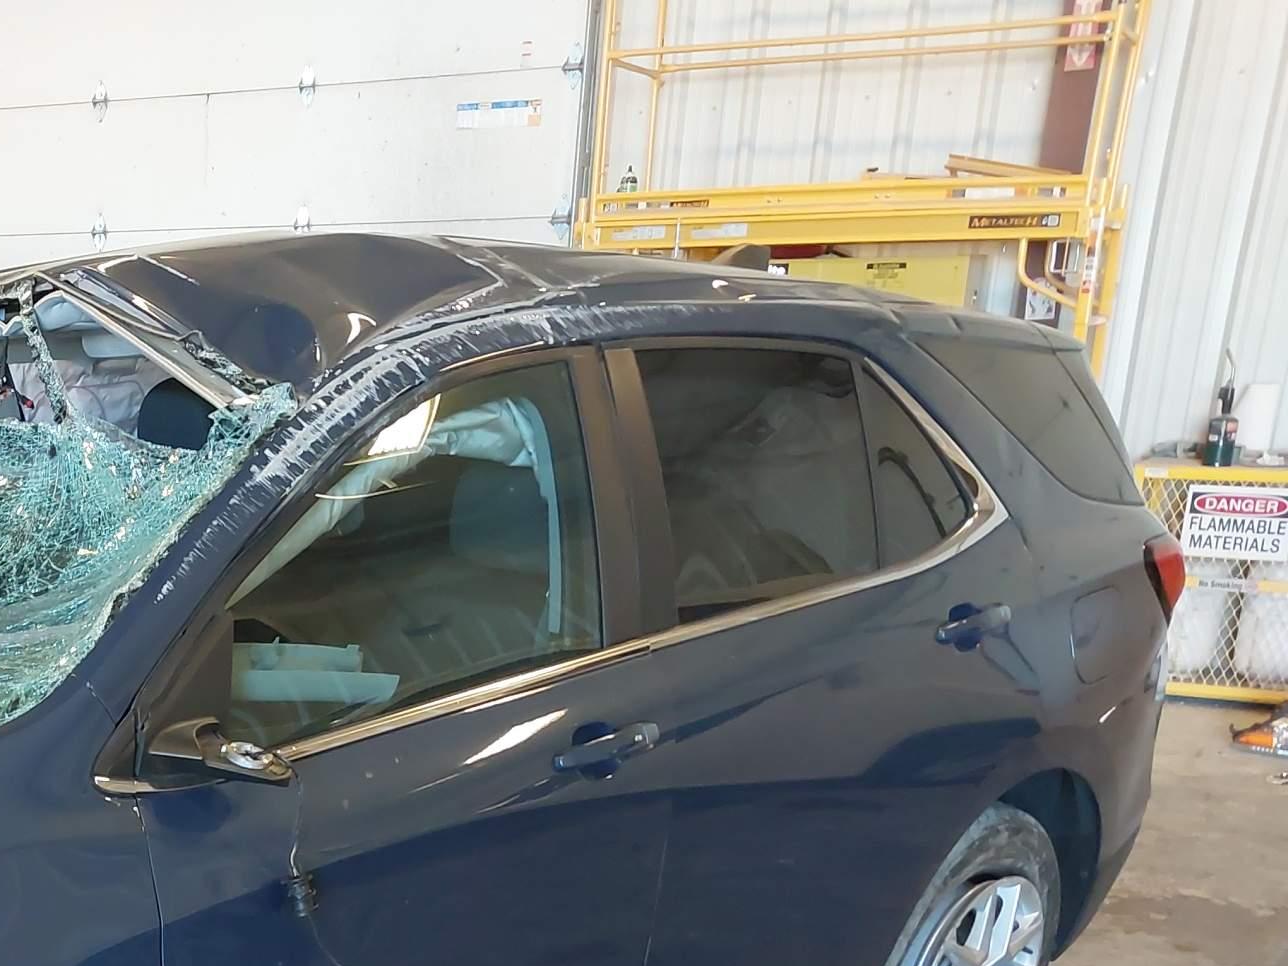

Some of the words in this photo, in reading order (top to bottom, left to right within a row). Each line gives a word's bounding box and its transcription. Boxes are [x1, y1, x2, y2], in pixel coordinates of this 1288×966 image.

[1204, 497, 1280, 514] DANGER
[1189, 516, 1288, 535] FLAMMABLE
[1189, 535, 1280, 553] MATERIALS
